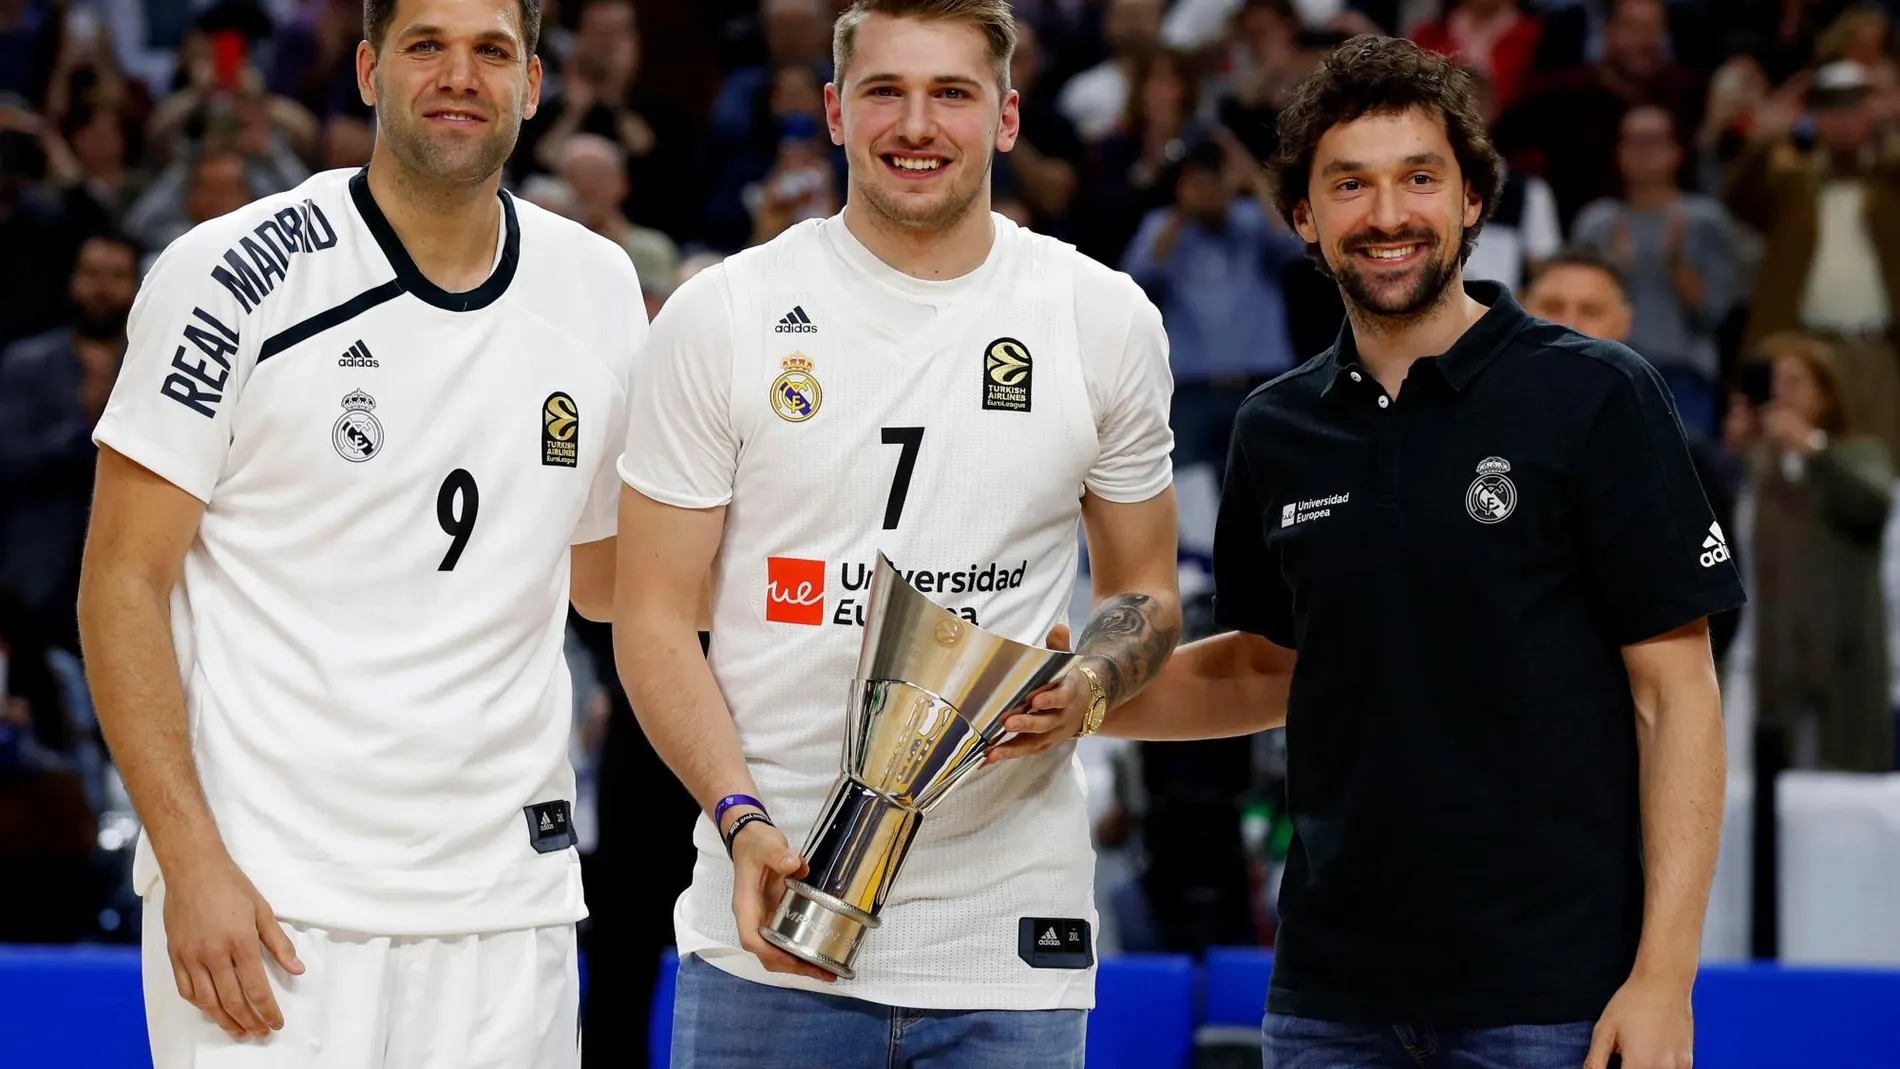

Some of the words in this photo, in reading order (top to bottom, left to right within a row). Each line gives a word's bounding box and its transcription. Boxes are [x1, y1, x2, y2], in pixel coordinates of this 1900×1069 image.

[160, 306, 239, 419] REAL
[211, 198, 338, 315] MADRID
[775, 323, 818, 334] adidas
[338, 357, 380, 368] adidas
[988, 384, 1026, 394] TURKISH
[988, 392, 1026, 401] AIRLINES
[546, 440, 576, 450] TURKISH
[546, 448, 576, 457] AIRLINES
[881, 427, 925, 530] 7
[1298, 492, 1350, 511] Universidad
[436, 468, 480, 572] 9
[1296, 508, 1331, 524] Europea
[1700, 541, 1731, 568] adi
[841, 560, 1028, 594] Uversidad
[1038, 938, 1061, 946] adidas
